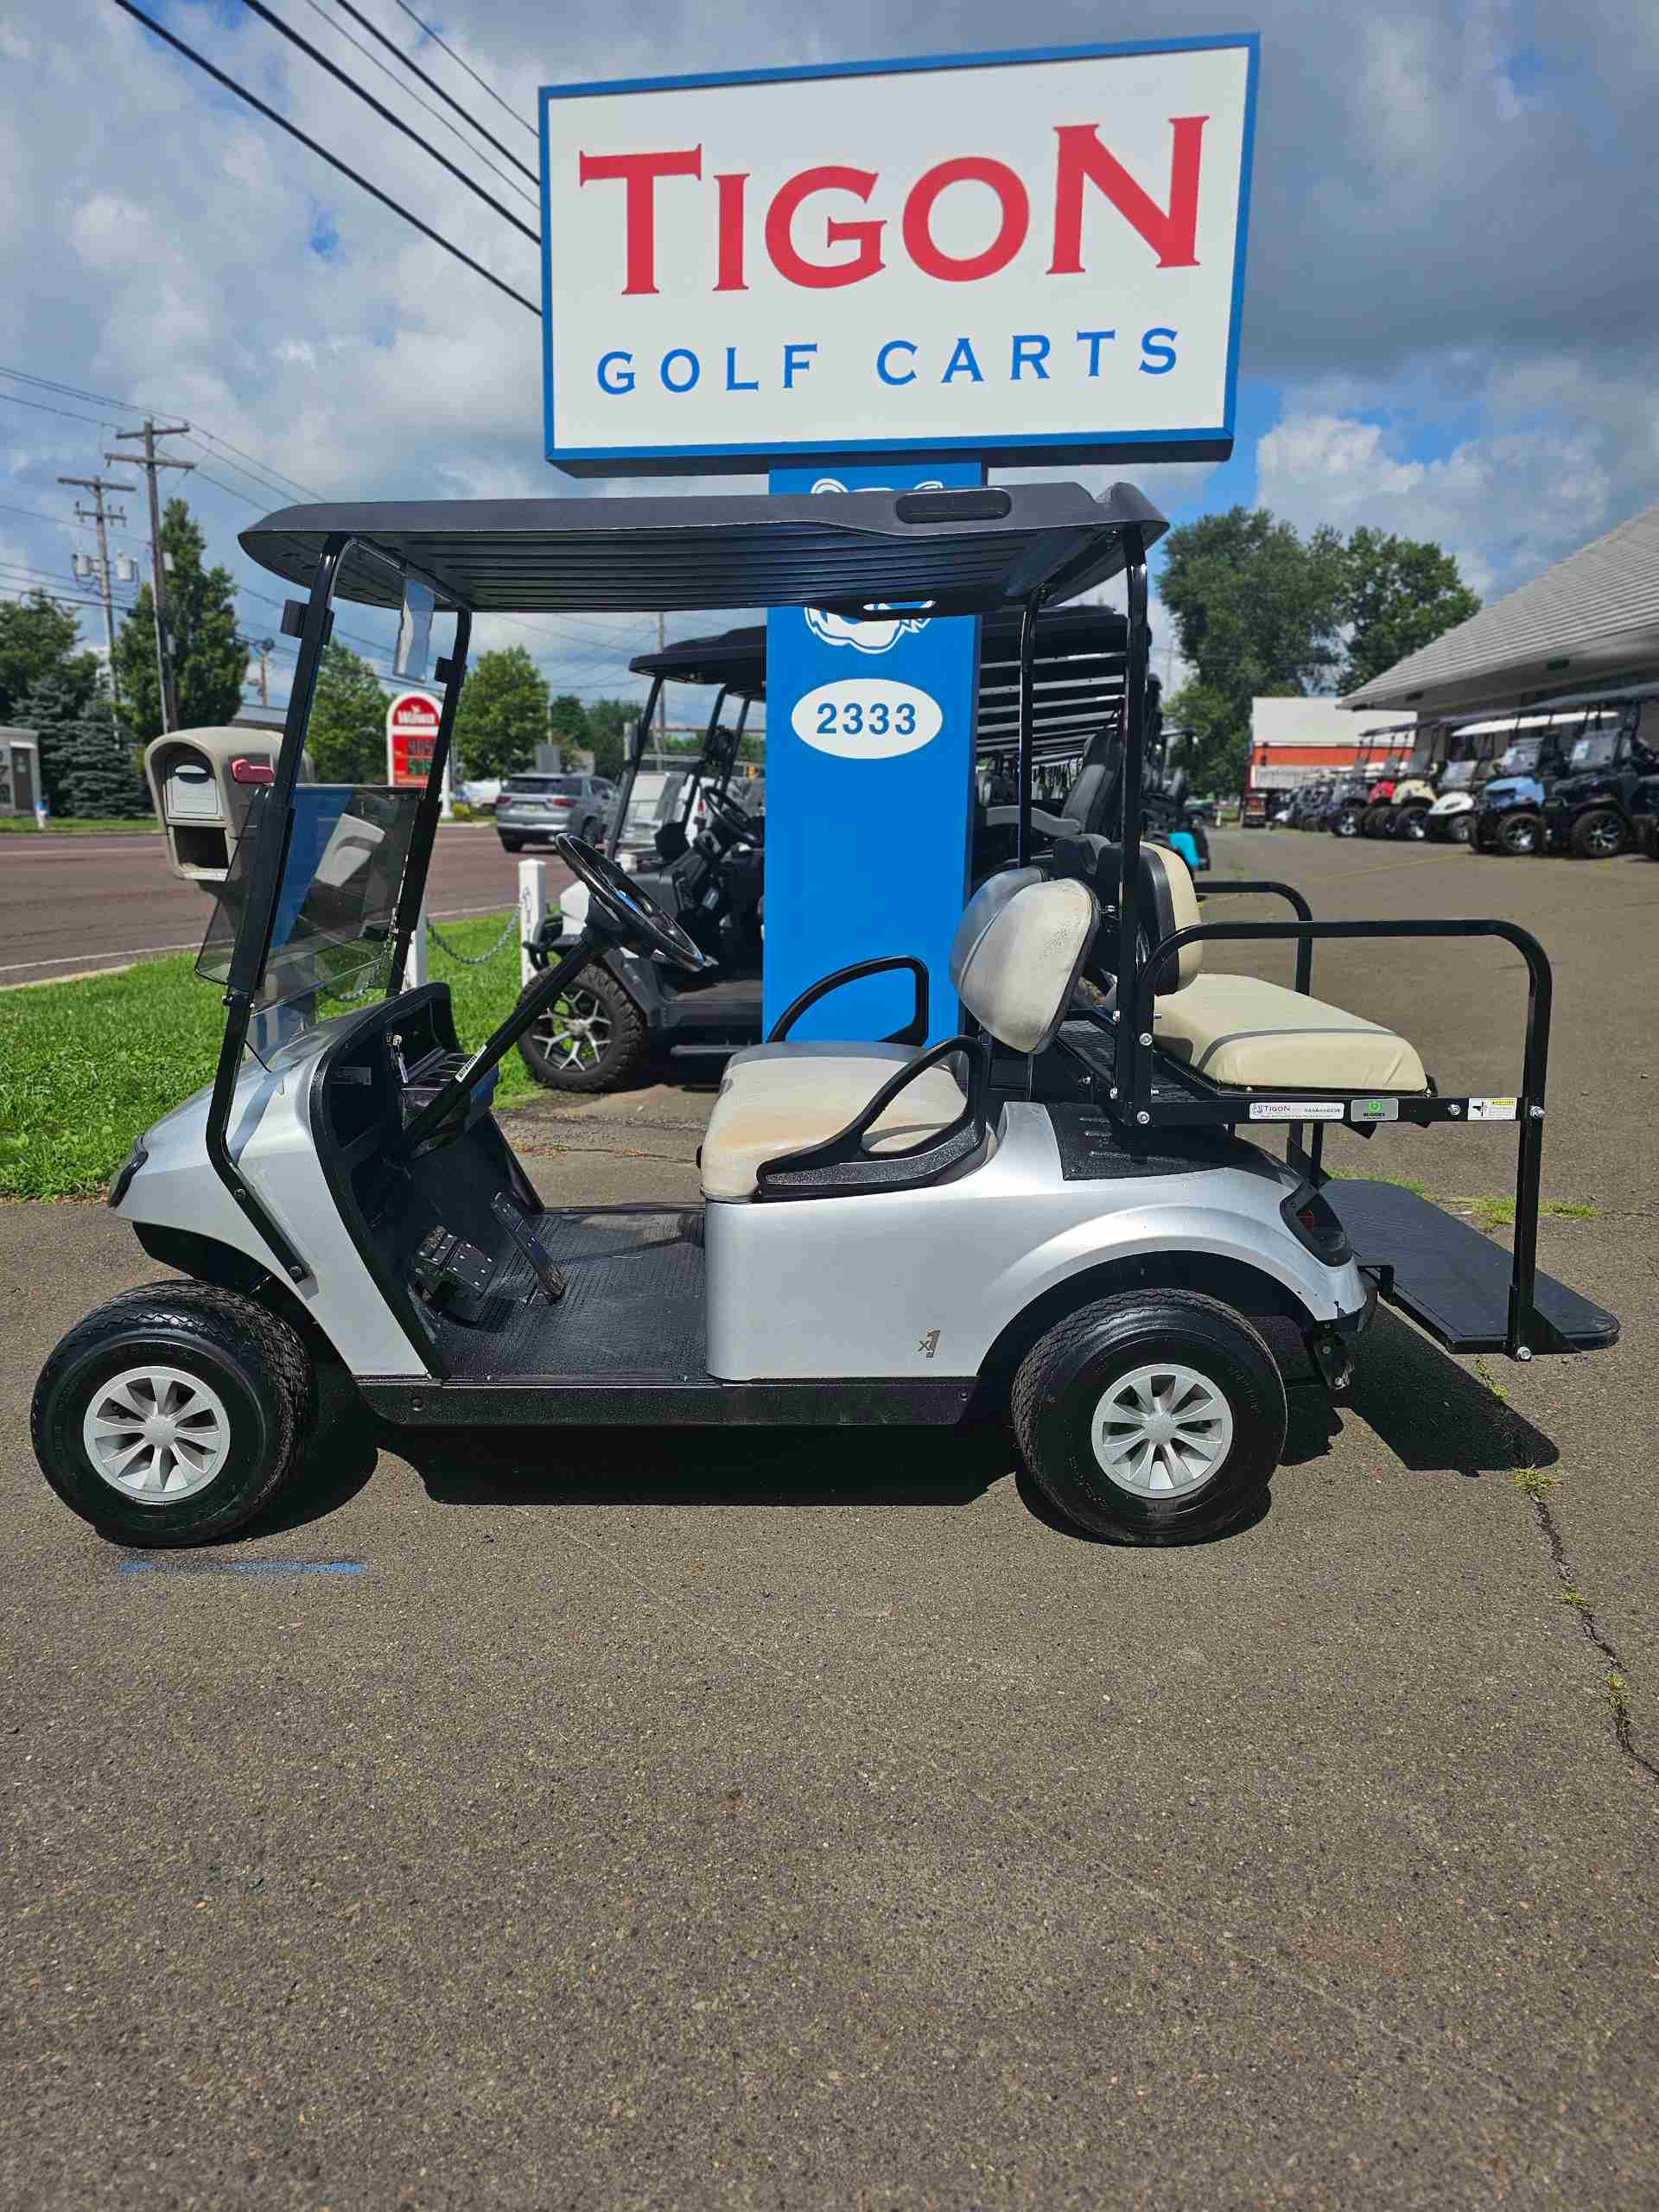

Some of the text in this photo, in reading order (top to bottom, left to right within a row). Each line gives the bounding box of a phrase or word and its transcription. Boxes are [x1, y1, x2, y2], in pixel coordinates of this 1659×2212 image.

[580, 115, 1208, 295] TIGON
[596, 325, 1177, 396] GOLF CARTS
[816, 700, 918, 734] 2333
